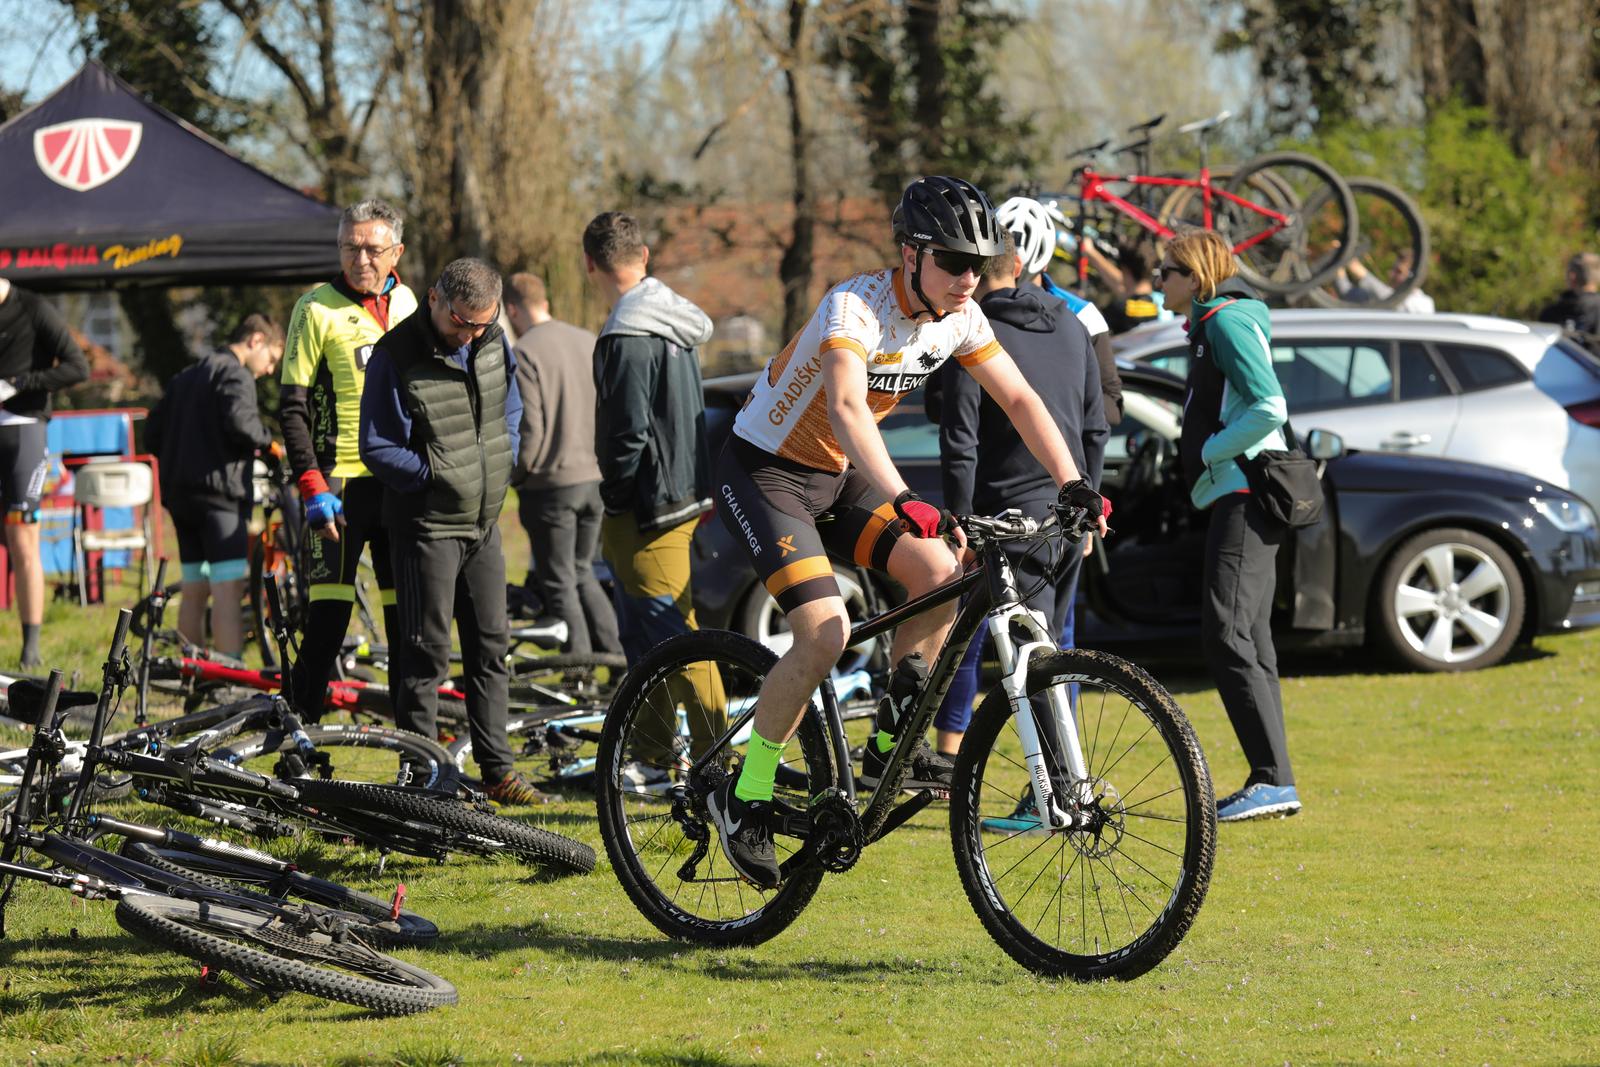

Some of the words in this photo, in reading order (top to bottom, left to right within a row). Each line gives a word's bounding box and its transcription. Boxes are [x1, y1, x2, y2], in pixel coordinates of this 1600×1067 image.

[102, 233, 183, 270] Timing
[768, 356, 822, 426] GRADIŠKA
[721, 484, 762, 556] CHALLENGE
